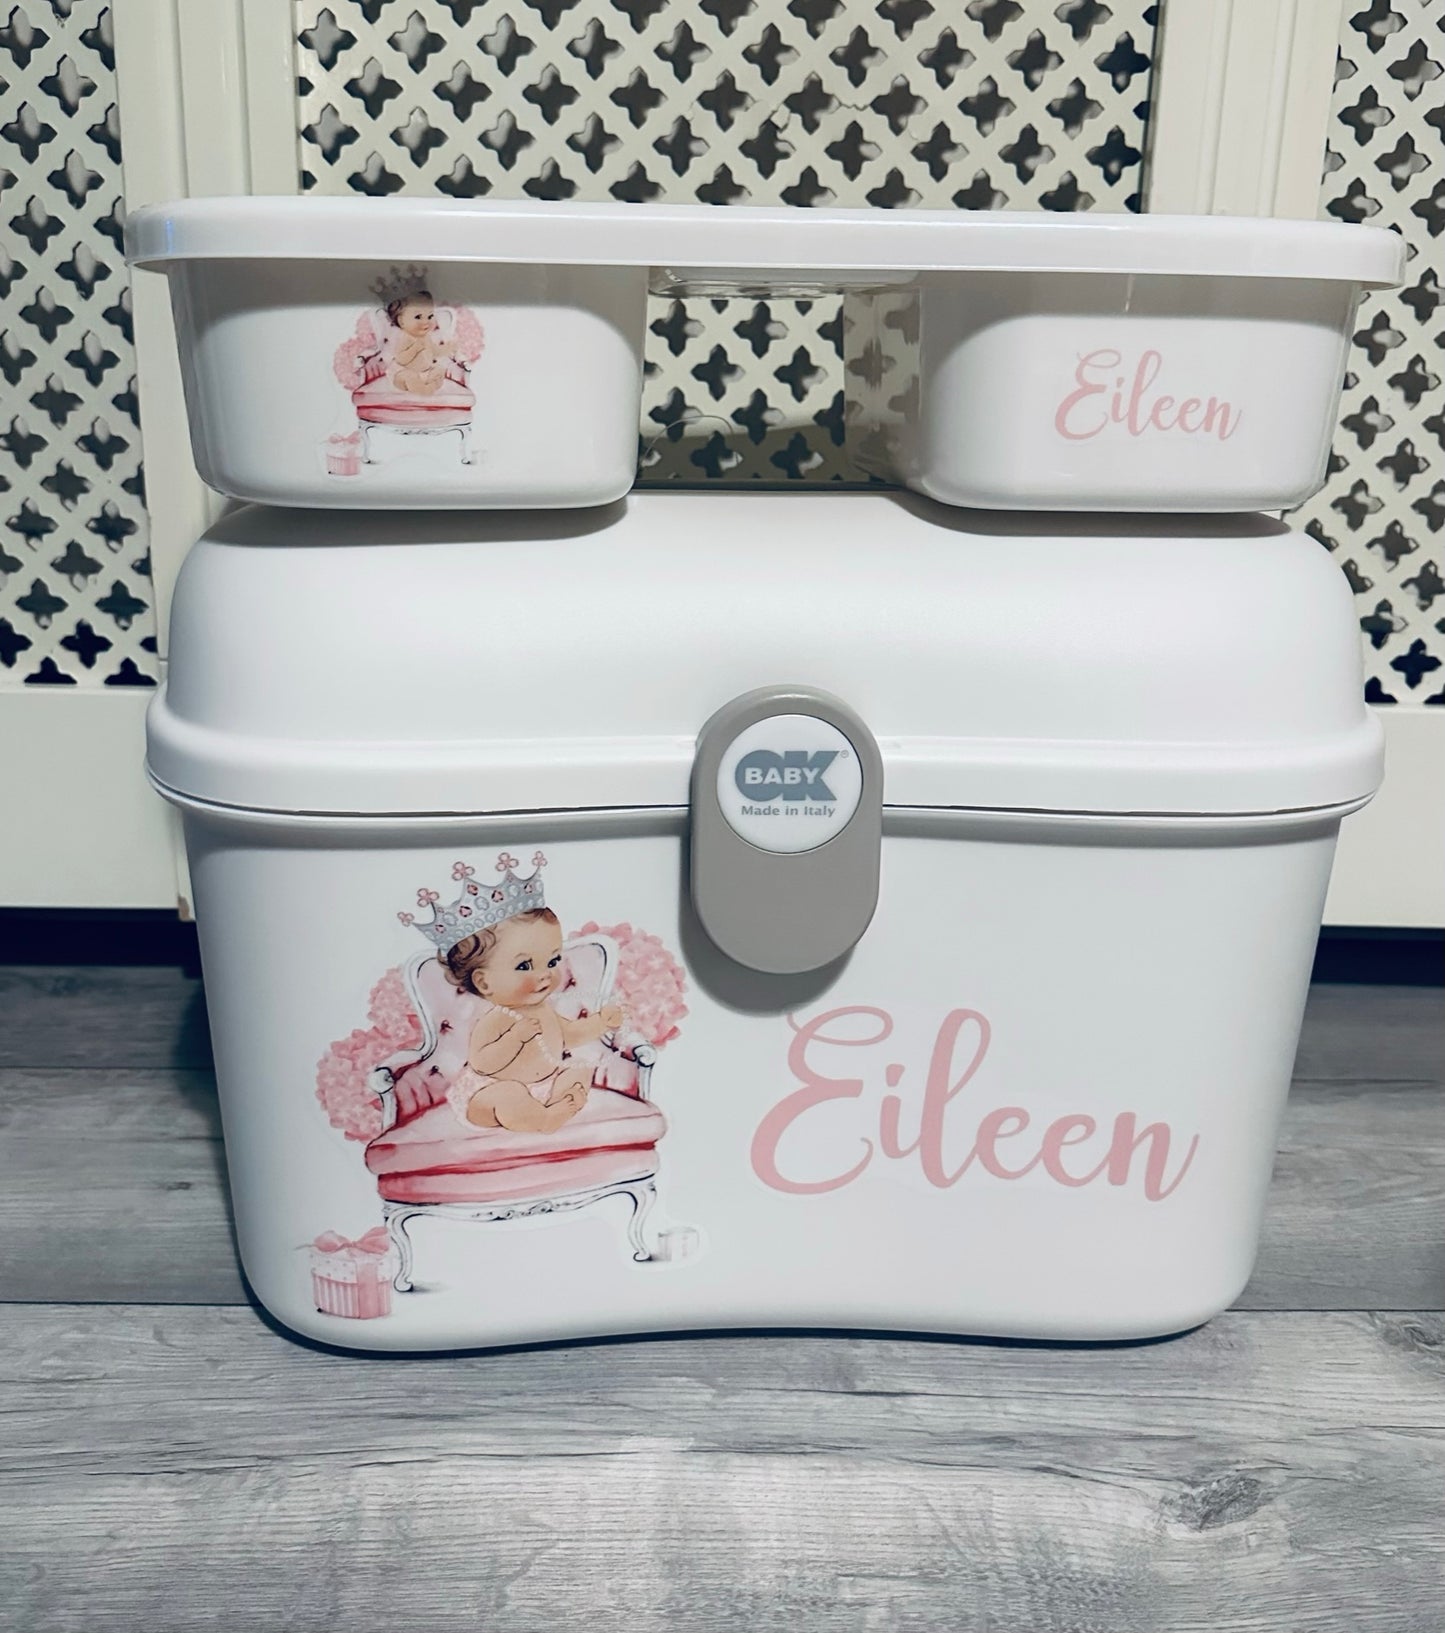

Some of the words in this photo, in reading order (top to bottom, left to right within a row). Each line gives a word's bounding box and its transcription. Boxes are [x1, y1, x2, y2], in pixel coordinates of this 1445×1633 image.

[1054, 348, 1242, 441] Eileen
[744, 767, 821, 785] BABY
[741, 805, 780, 816] Made
[785, 805, 798, 816] in
[804, 805, 836, 818] Italy
[750, 1005, 1200, 1202] Eileen
